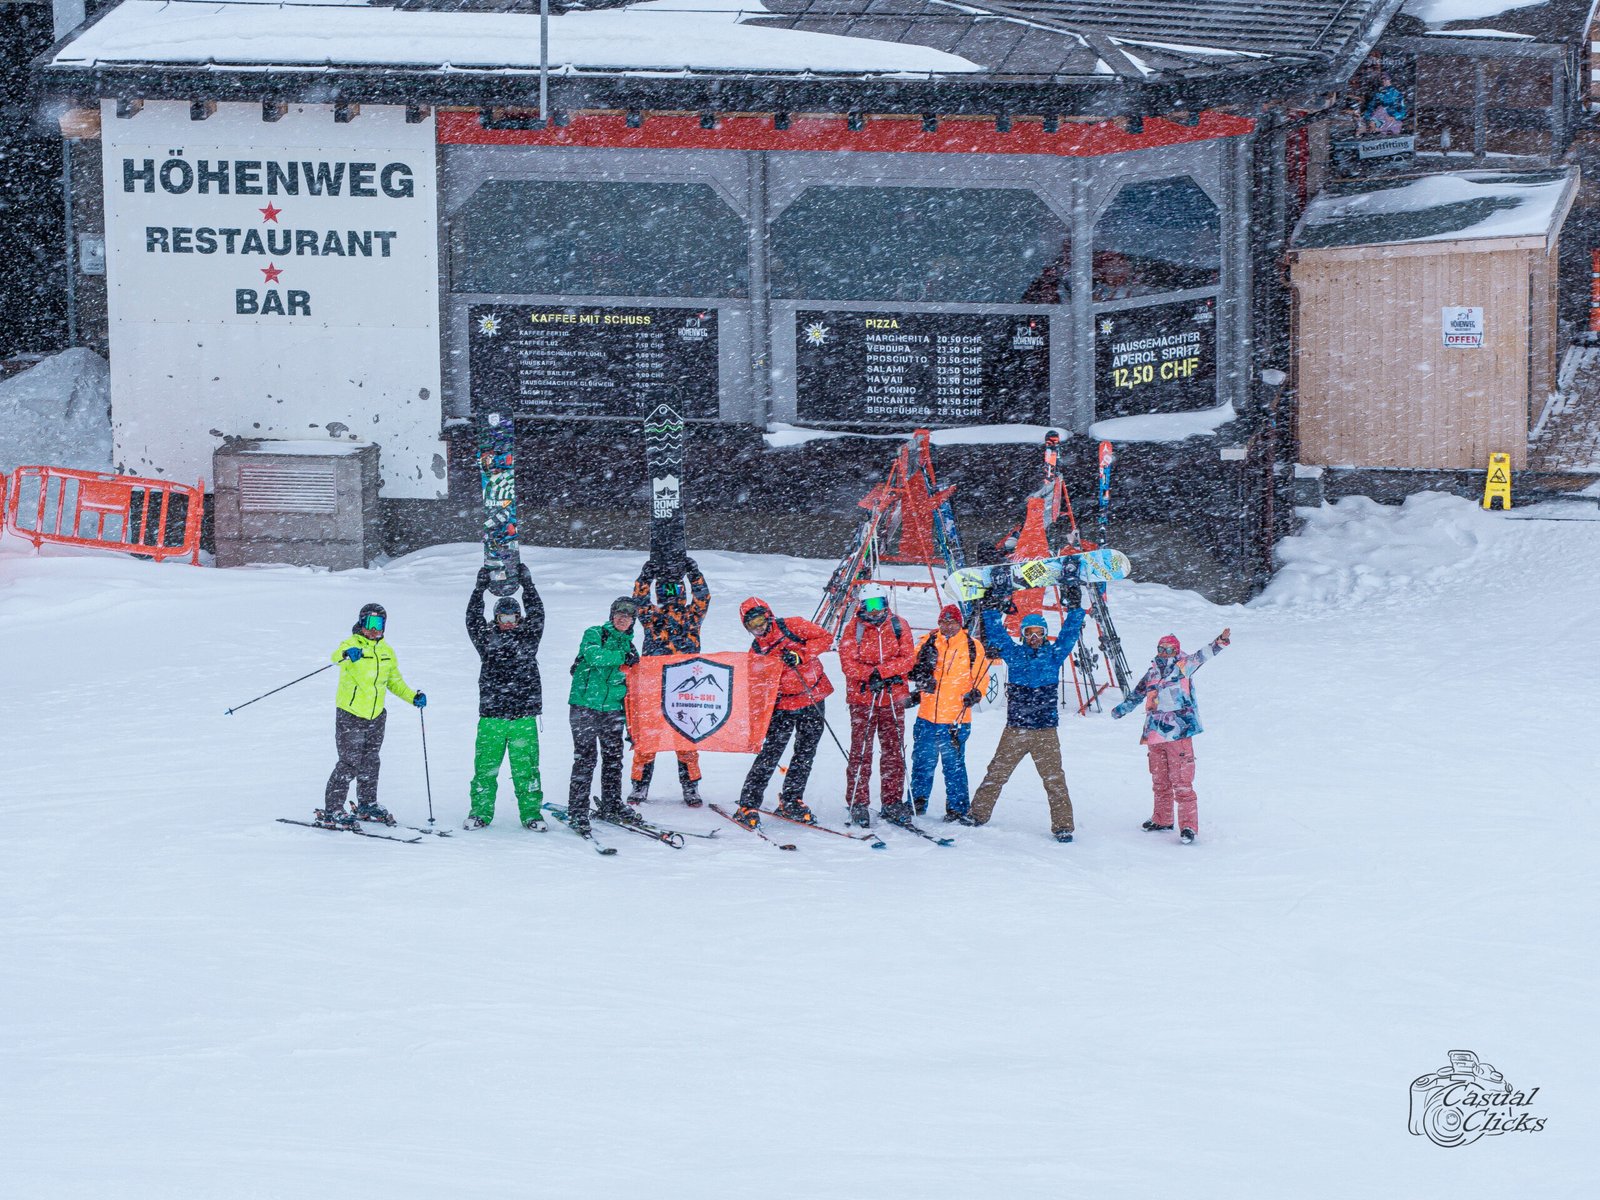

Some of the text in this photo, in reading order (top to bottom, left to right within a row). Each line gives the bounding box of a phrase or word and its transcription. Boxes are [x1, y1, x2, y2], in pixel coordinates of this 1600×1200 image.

[1362, 140, 1409, 151] bootfitting
[123, 149, 414, 198] HÖHENWEG
[146, 227, 397, 257] RESTAURANT
[236, 289, 311, 316] BAR
[532, 314, 650, 324] KAFFEE MIT SCHUSS
[866, 319, 898, 328] PIZZA
[866, 335, 930, 343] MARGHERITA
[1112, 332, 1200, 353] HAUSGEMACHTER
[866, 355, 927, 363] PROSCIUTTO
[1113, 344, 1200, 367] APEROL SPRITZ
[867, 365, 904, 373] SALAMI
[1113, 358, 1199, 389] 12,50 CHF
[867, 396, 915, 404] PICCANTE
[866, 406, 930, 415] BERGFÜHRER
[654, 500, 679, 509] ROME
[654, 509, 672, 518] SDS
[678, 693, 716, 701] POL-SKI
